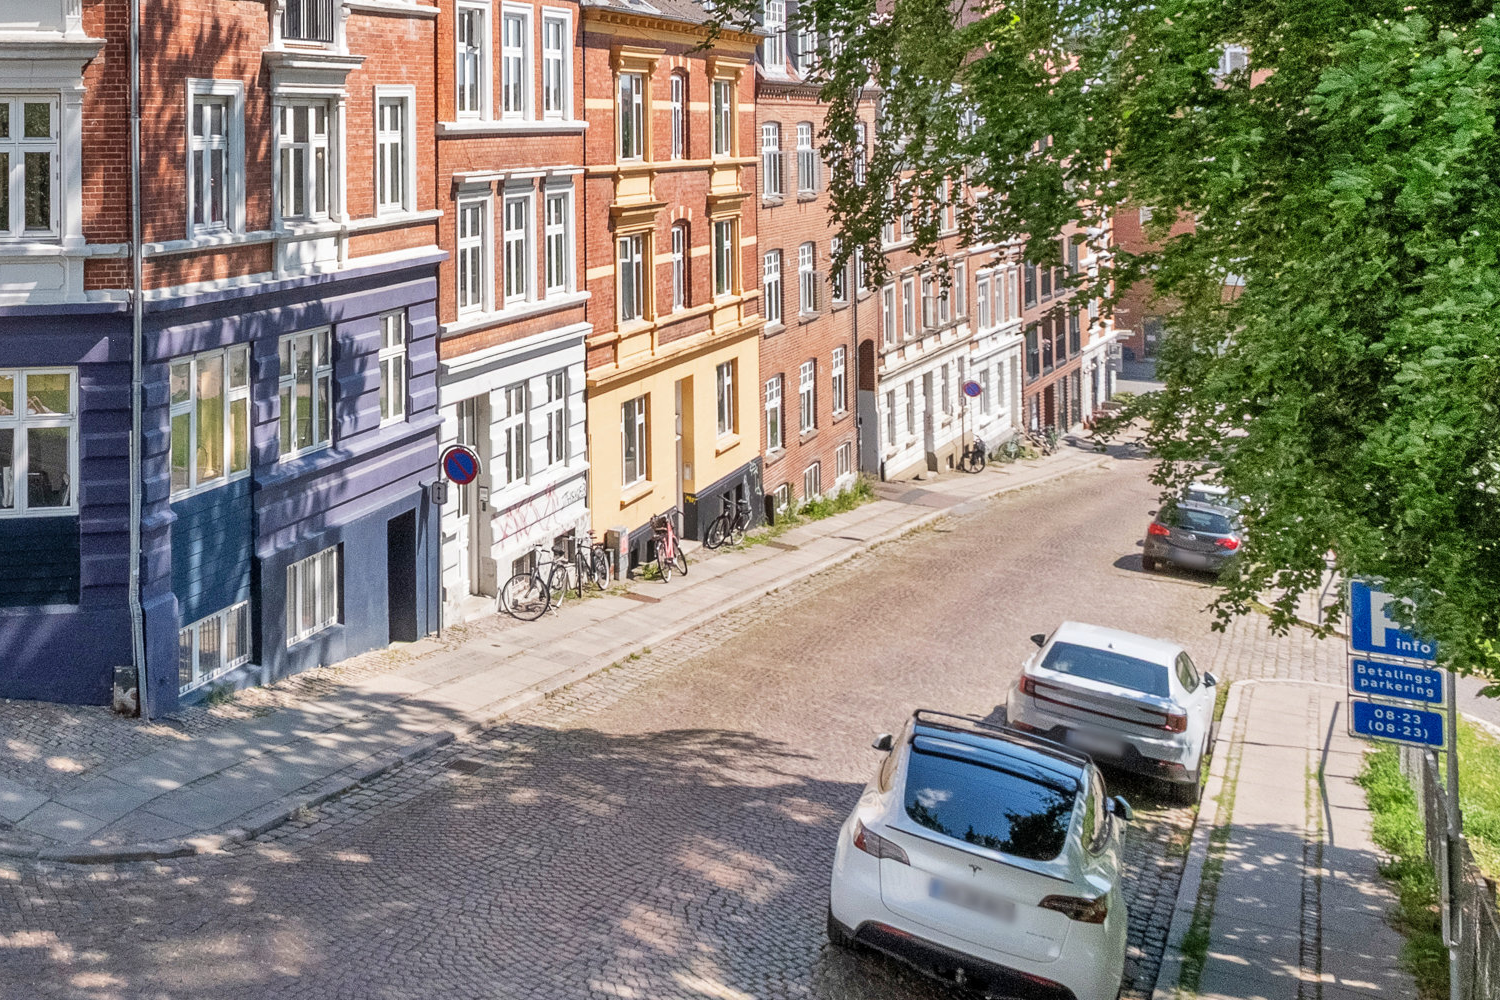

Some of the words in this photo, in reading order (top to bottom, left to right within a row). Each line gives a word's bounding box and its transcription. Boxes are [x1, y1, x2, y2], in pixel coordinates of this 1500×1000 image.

[1396, 638, 1431, 654] info
[1357, 664, 1437, 684] Betalings-
[1360, 678, 1434, 697] parkering
[1374, 708, 1422, 725] 08-23
[1368, 720, 1429, 739] (08-23)
